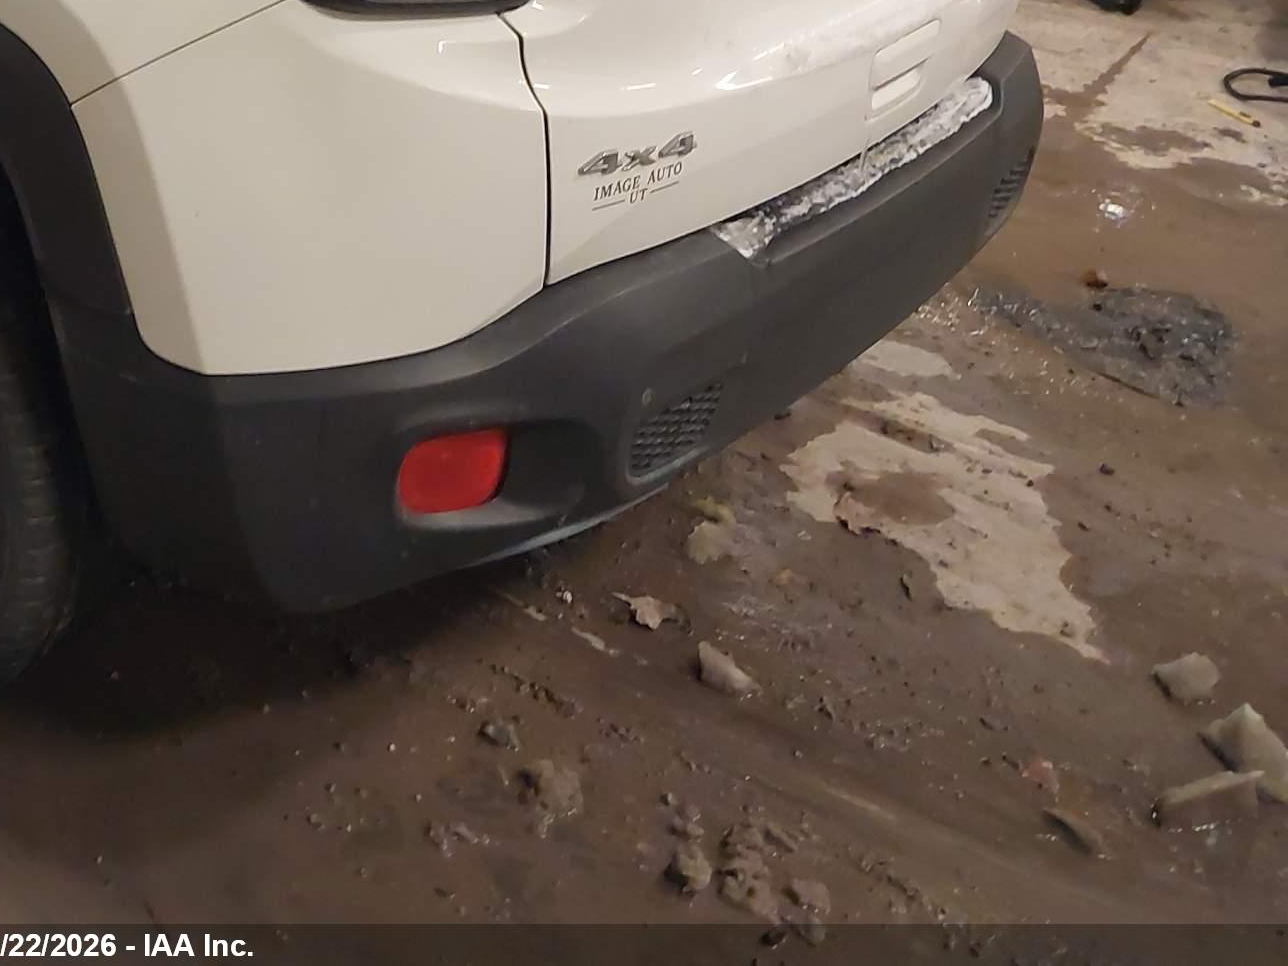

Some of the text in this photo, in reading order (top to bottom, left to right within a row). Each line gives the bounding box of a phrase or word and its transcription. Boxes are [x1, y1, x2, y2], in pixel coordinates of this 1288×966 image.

[578, 131, 697, 176] 4x4
[593, 161, 683, 201] IMAGE AUTO
[629, 187, 649, 204] UT
